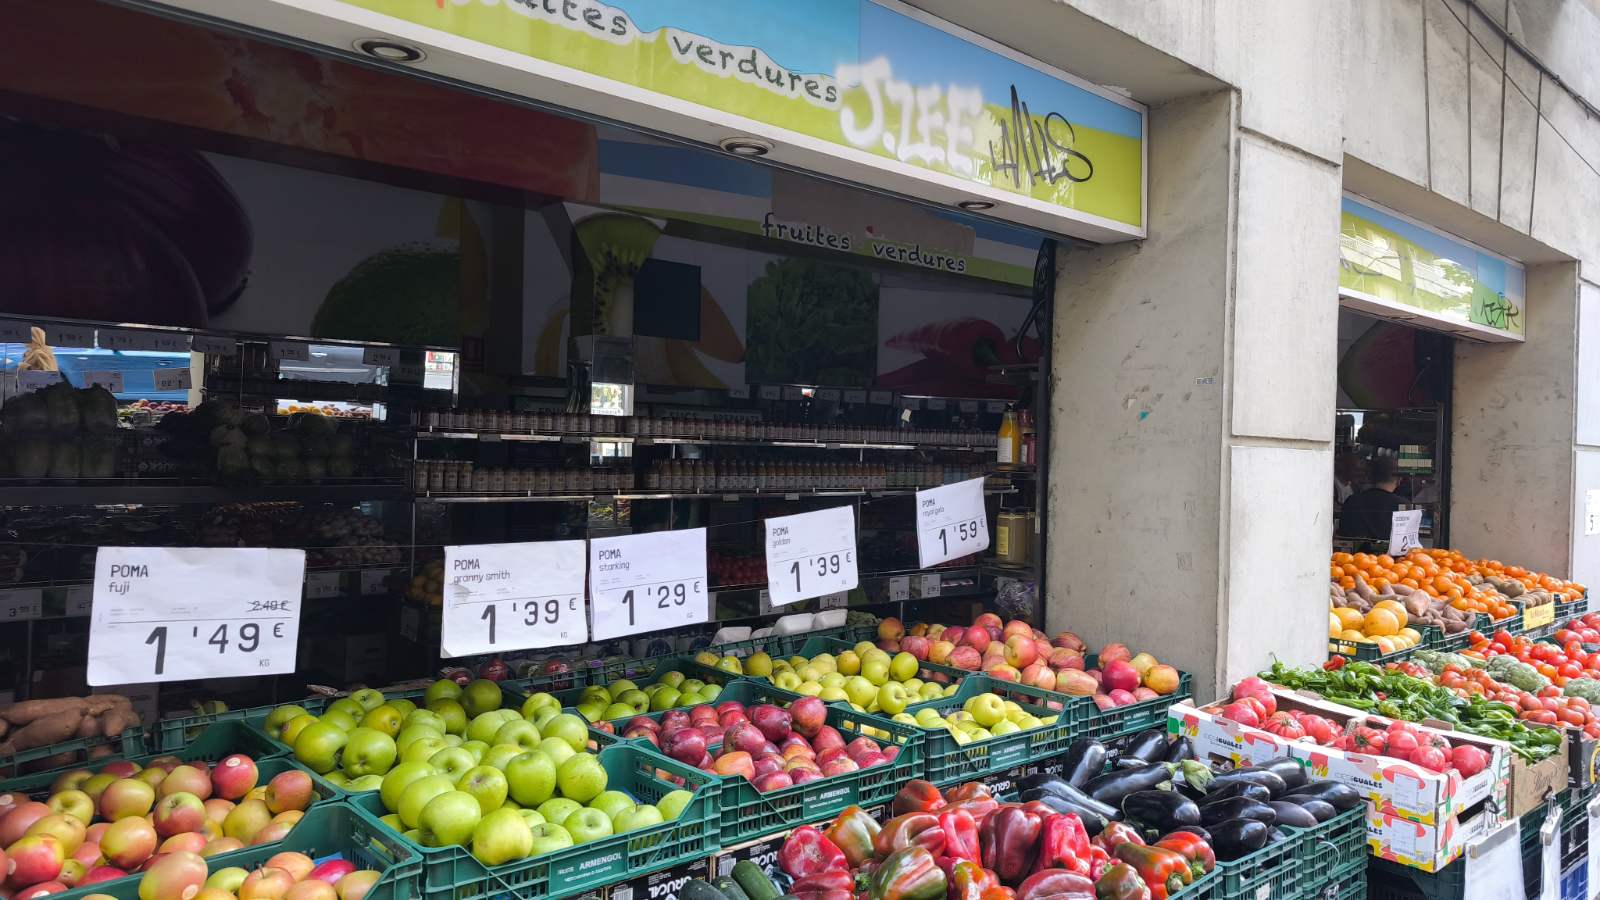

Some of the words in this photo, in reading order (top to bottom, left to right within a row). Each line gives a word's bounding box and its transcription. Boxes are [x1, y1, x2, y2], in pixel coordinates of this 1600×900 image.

[672, 35, 838, 103] verdures
[762, 212, 851, 250] fruites
[872, 242, 966, 272] verdures
[922, 498, 935, 508] POMA
[772, 526, 789, 537] POMA
[598, 548, 622, 560] POMA
[110, 564, 149, 578] POMA
[453, 558, 480, 571] POMA
[598, 560, 630, 572] starking
[453, 572, 484, 584] granny
[485, 570, 511, 582] smith
[108, 581, 131, 595] fuji
[569, 597, 577, 611] €
[273, 622, 285, 638] €
[259, 658, 271, 667] KG
[579, 852, 623, 871] ARMENGOL
